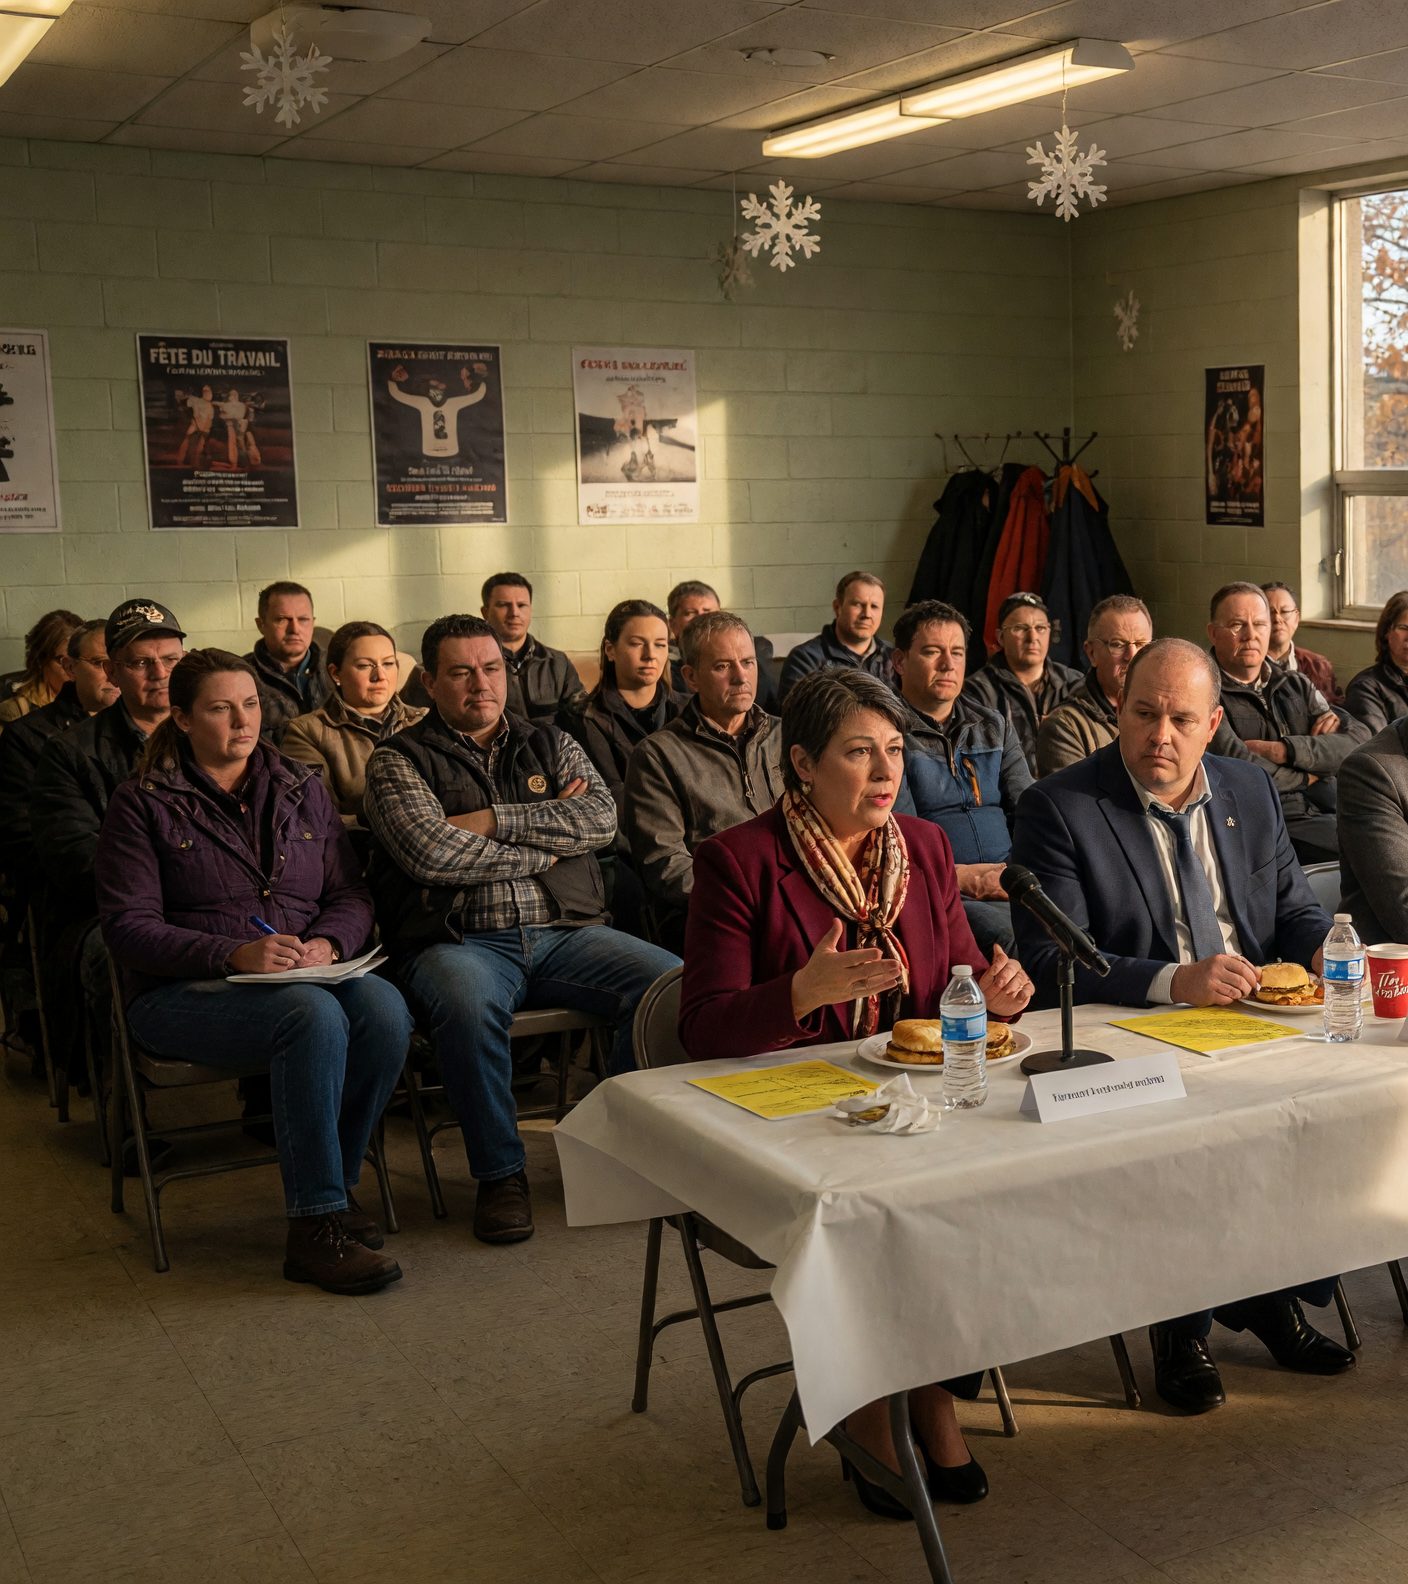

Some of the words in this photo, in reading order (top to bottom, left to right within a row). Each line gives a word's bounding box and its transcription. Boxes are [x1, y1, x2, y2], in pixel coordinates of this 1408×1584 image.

[150, 342, 188, 365] FÊTE
[191, 349, 213, 365] DU
[217, 350, 280, 367] TRAVAIL
